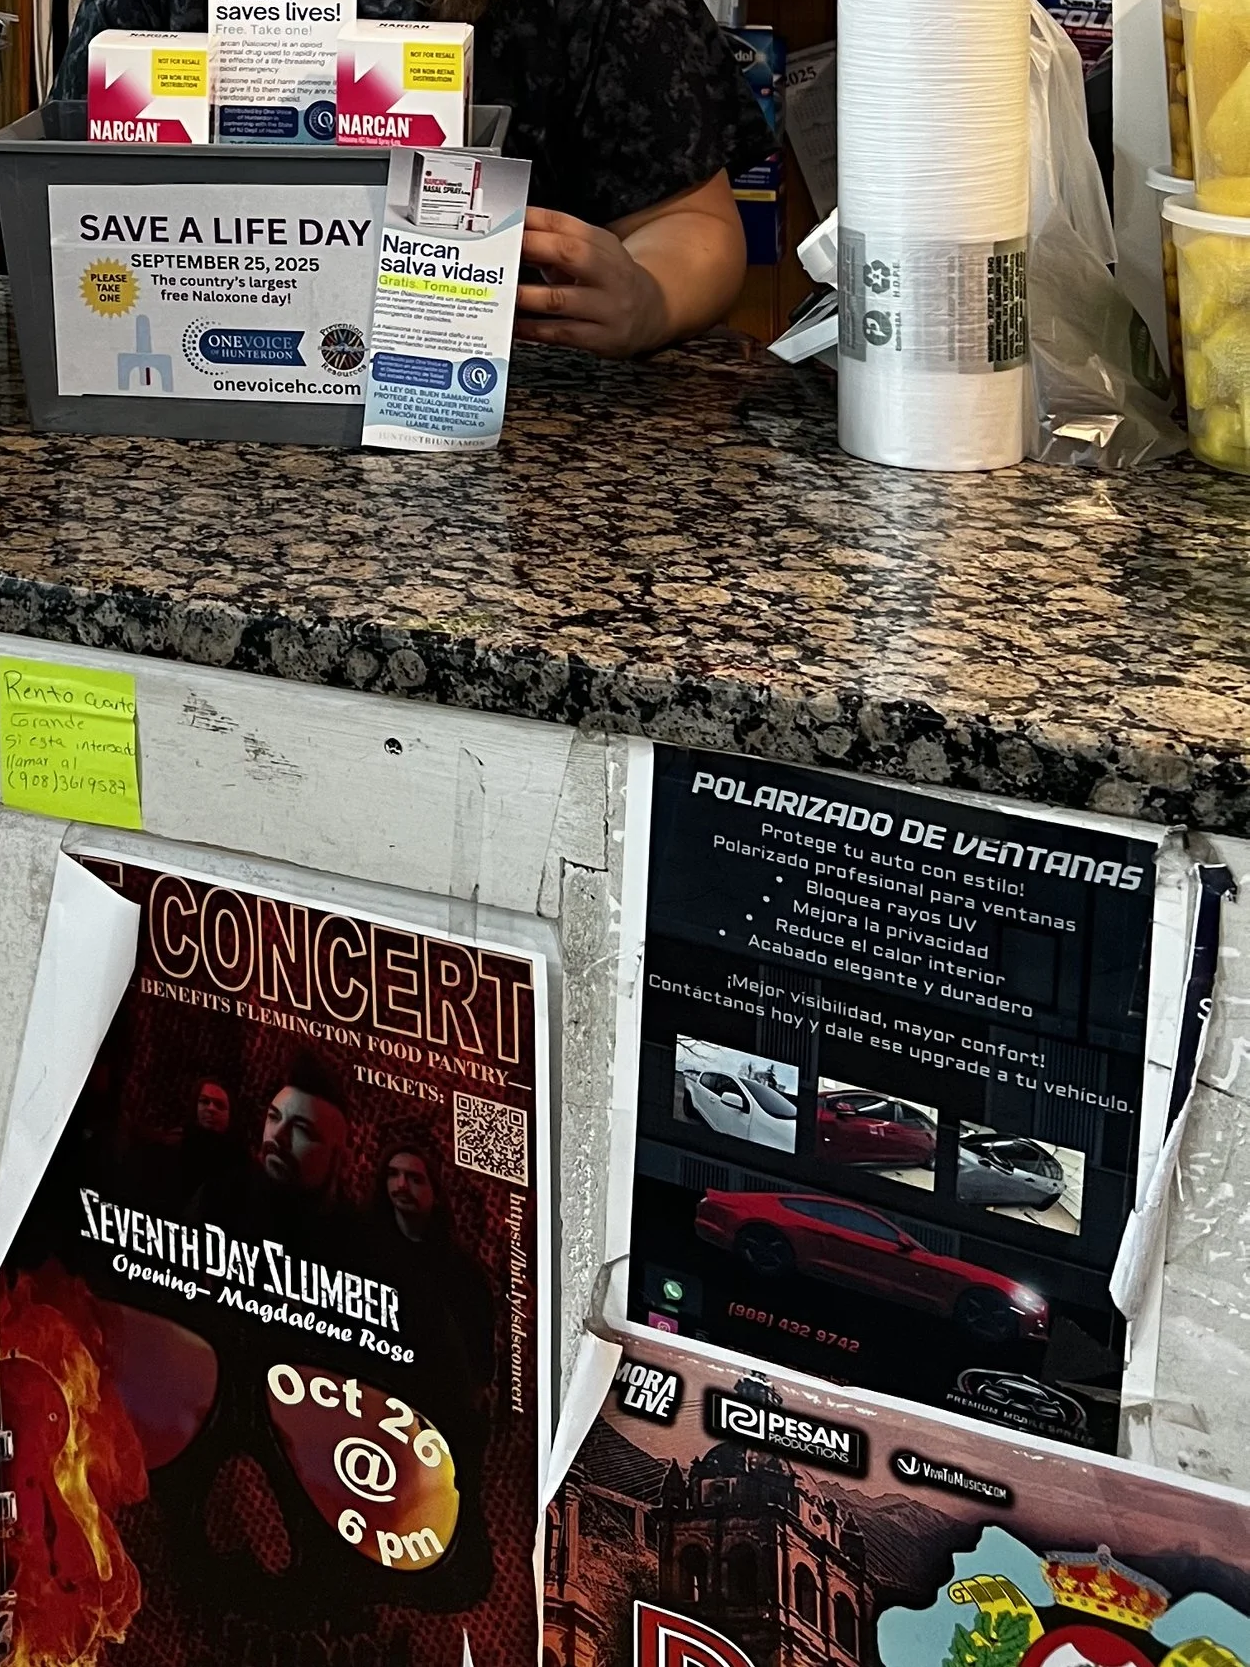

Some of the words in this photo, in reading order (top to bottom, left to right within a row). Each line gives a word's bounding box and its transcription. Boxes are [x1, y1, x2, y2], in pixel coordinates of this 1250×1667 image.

[216, 5, 280, 21] saves
[285, 2, 342, 22] lives!
[251, 24, 282, 36] Take
[285, 24, 313, 36] one!
[90, 119, 158, 142] NARCAN
[337, 113, 410, 138] NARCAN
[79, 214, 170, 243] SAVE
[178, 216, 204, 244] A
[213, 216, 287, 245] LIFE
[298, 219, 372, 247] DAY
[382, 234, 459, 260] Narcan
[90, 273, 128, 283] PLEASE
[130, 253, 239, 271] SEPTEMBER
[244, 256, 271, 274] 25,
[274, 256, 320, 272] 2025
[380, 256, 440, 278] salva
[442, 260, 505, 285] vidas!
[96, 283, 121, 293] TAKE
[99, 293, 121, 303] ONE
[151, 274, 176, 286] The
[249, 275, 297, 292] largest
[161, 289, 189, 302] free
[192, 290, 258, 304] Naloxone
[261, 292, 292, 307] day!
[424, 279, 457, 295] Toma
[460, 284, 489, 297] uno!
[321, 322, 364, 337] Prevention
[221, 348, 294, 361] HUNTERDON
[321, 361, 367, 378] Resources
[213, 378, 362, 396] onevoicehc.com
[692, 772, 894, 838] POLARIZADO
[900, 819, 948, 850] DE
[953, 832, 1144, 891] VENTANAS
[761, 823, 837, 854] Protege
[843, 843, 864, 859] tu
[871, 851, 914, 872] auto
[921, 864, 956, 882] con
[963, 873, 1025, 897] estilo!
[713, 835, 809, 870] Polarizado
[815, 864, 924, 897] profesional
[930, 889, 975, 910] para
[982, 902, 1077, 932] ventanas
[806, 880, 881, 910] Bloquea
[887, 902, 941, 925] rayos
[948, 915, 977, 933] UV
[150, 873, 533, 1064] CONCERT
[140, 977, 231, 1014] BENEFITS
[235, 1001, 361, 1048] FLEMINGTON
[367, 1035, 422, 1063] FOOD
[727, 974, 785, 998] ¡Mejor
[790, 991, 887, 1029] visibilidad,
[893, 1018, 955, 1044] mayor
[961, 1037, 1046, 1068] confort!
[353, 1064, 445, 1104] TICKETS:
[80, 1187, 199, 1270] SEVENTH
[204, 1222, 259, 1288] DAY
[263, 1239, 400, 1332] SLUMBER
[505, 1192, 526, 1414] https://bit.ly/sdsconcert
[217, 1286, 352, 1342] Magdalene
[358, 1327, 415, 1363] Rose
[778, 1318, 811, 1338] 432
[816, 1330, 860, 1353] 9742
[267, 1364, 362, 1418] Oct
[378, 1397, 450, 1468] 26
[768, 1432, 850, 1464] PRODUCTIONS
[769, 1413, 850, 1453] PESAN
[333, 1437, 397, 1502] @
[337, 1509, 367, 1544] 6
[376, 1527, 445, 1566] pm
